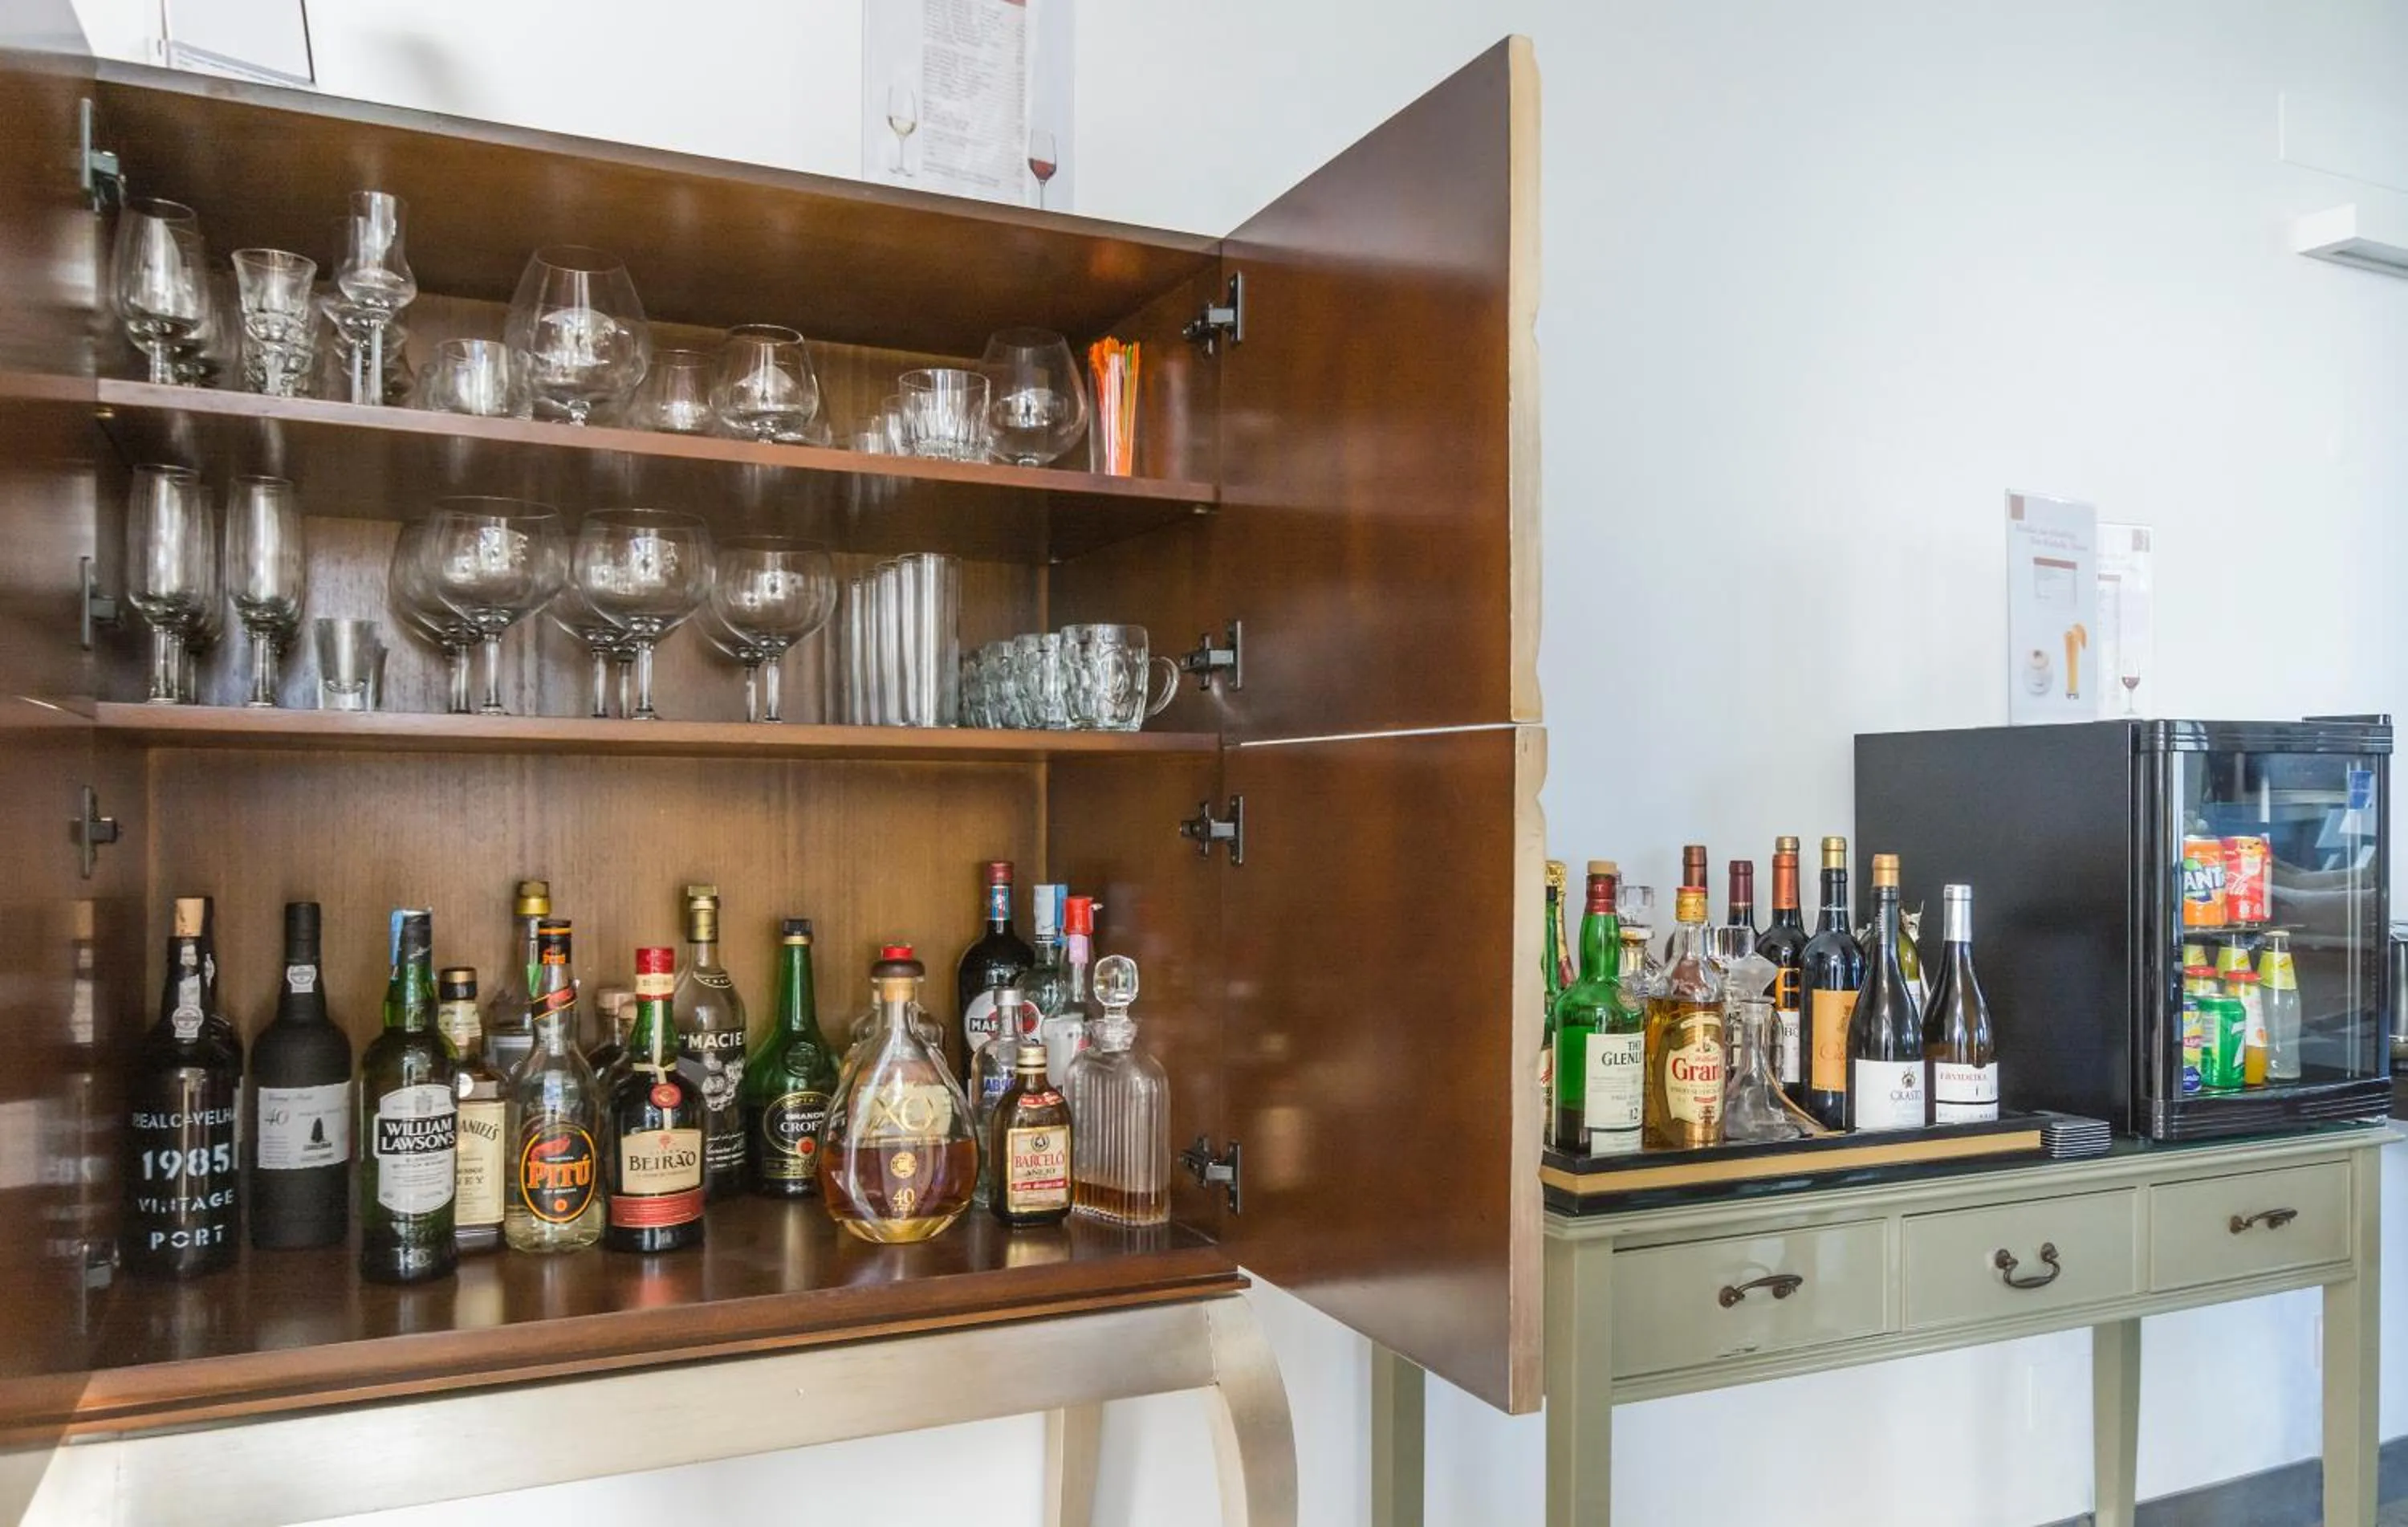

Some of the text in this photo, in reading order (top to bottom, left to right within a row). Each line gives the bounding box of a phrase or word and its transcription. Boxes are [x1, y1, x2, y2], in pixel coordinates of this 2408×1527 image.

[385, 1118, 453, 1137] WILLIAM
[141, 1142, 231, 1181] 1985
[628, 1150, 697, 1172] BEIRÃO
[1015, 1150, 1065, 1168] BARCELÓ
[527, 1153, 592, 1189] PITÚ
[892, 1187, 915, 1204] 40
[149, 1224, 226, 1251] PORT
